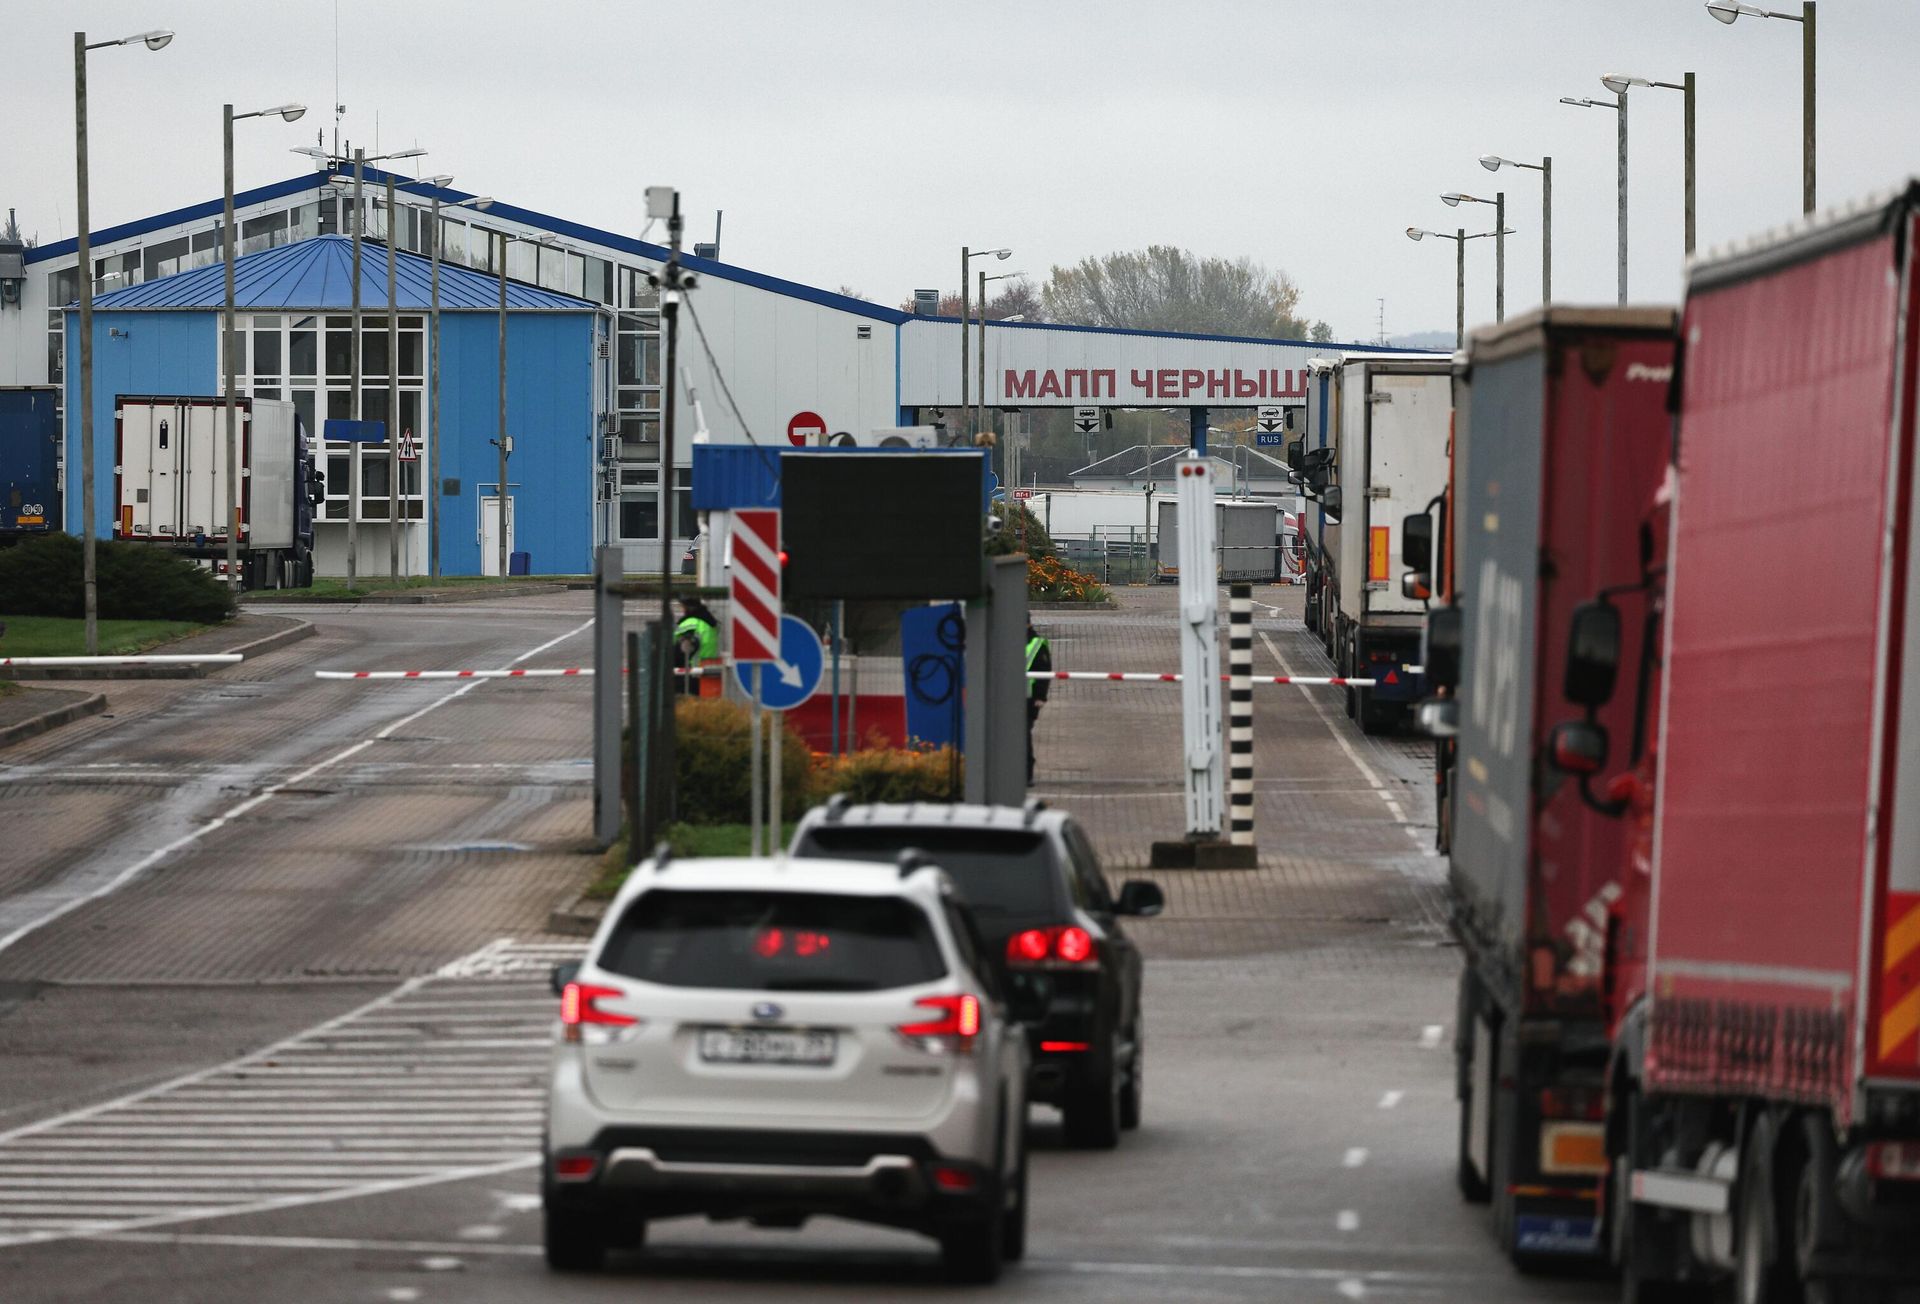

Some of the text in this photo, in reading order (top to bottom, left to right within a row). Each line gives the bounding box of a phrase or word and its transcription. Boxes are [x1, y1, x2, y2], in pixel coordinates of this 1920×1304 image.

[1005, 369, 1308, 398] МАПП ЧЕРНЫШ
[1260, 435, 1279, 443] RUS
